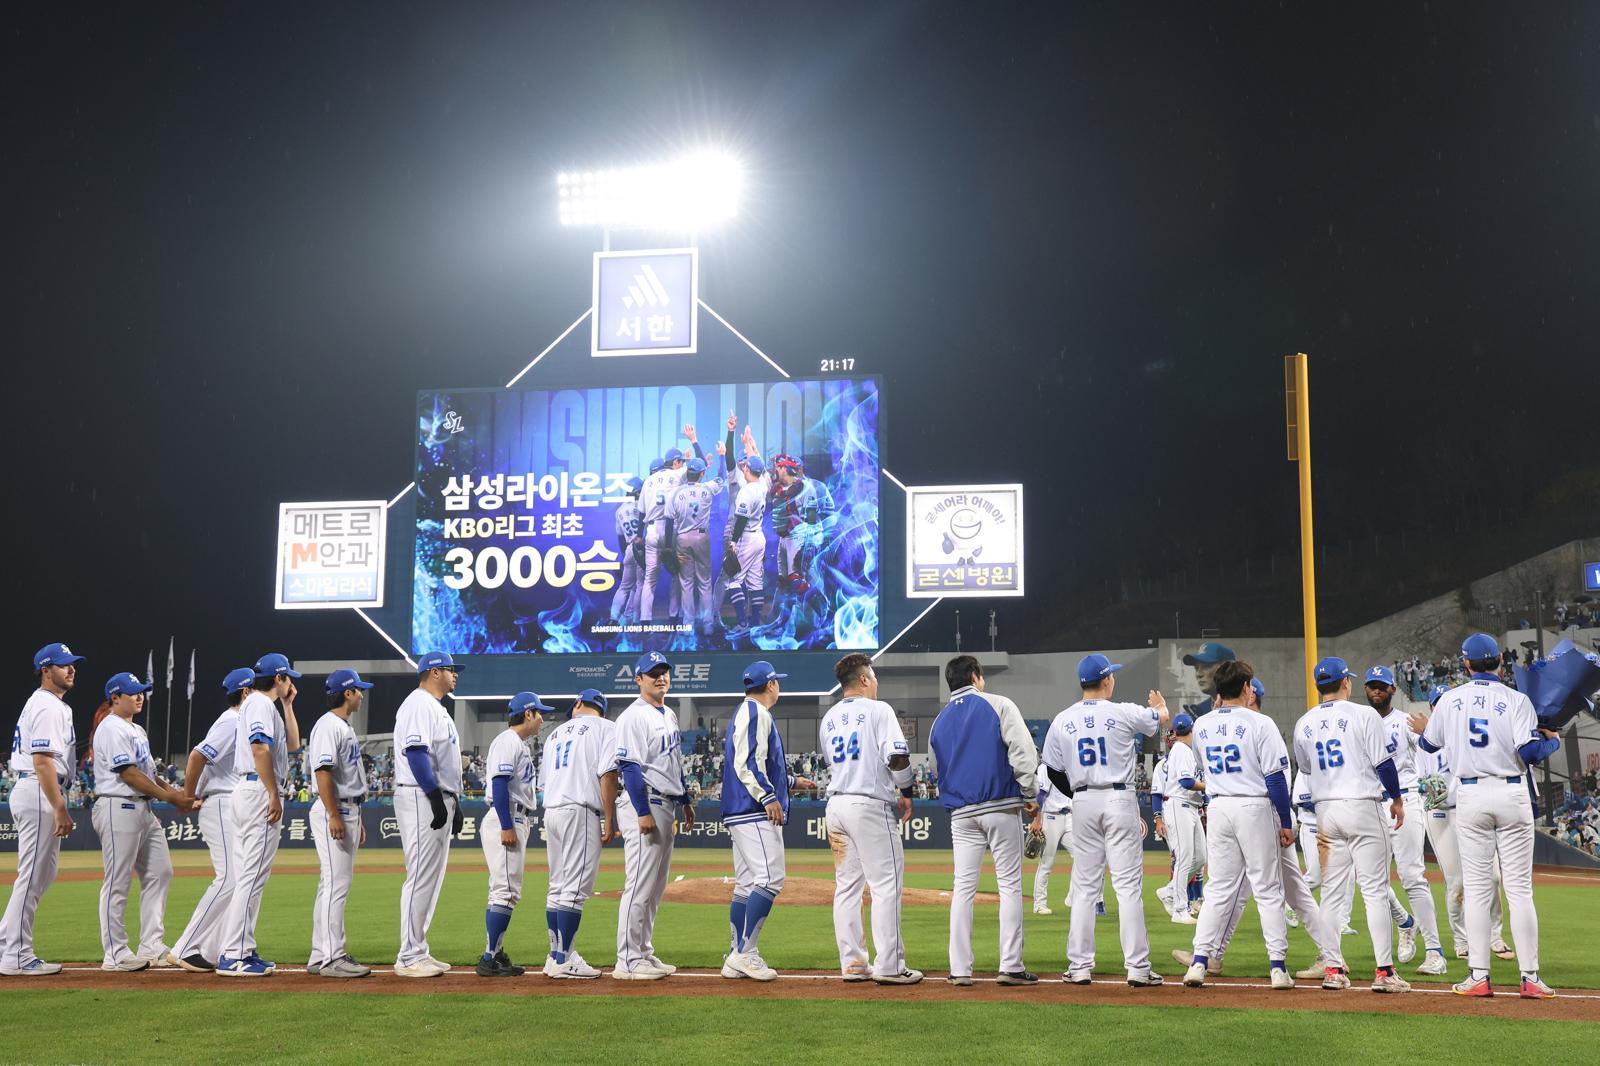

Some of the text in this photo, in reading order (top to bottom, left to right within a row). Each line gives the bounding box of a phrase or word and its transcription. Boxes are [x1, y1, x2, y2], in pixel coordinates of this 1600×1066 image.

[615, 314, 674, 341] 서한
[820, 358, 855, 372] 21:17
[441, 472, 635, 511] 삼성라이온즈
[294, 512, 373, 539] 메트로
[444, 513, 584, 540] KBO리그 최초
[443, 540, 621, 592] 3000승
[591, 625, 623, 633] SAMSUNG
[676, 624, 693, 632] CLUB
[1452, 695, 1507, 716] 구자욱
[1063, 715, 1116, 735] 전병우
[1469, 717, 1489, 748] 5
[555, 740, 573, 770] 11
[831, 731, 861, 764] 34
[1077, 736, 1107, 766] 61
[1206, 743, 1243, 774] 52
[1315, 738, 1345, 770] 16
